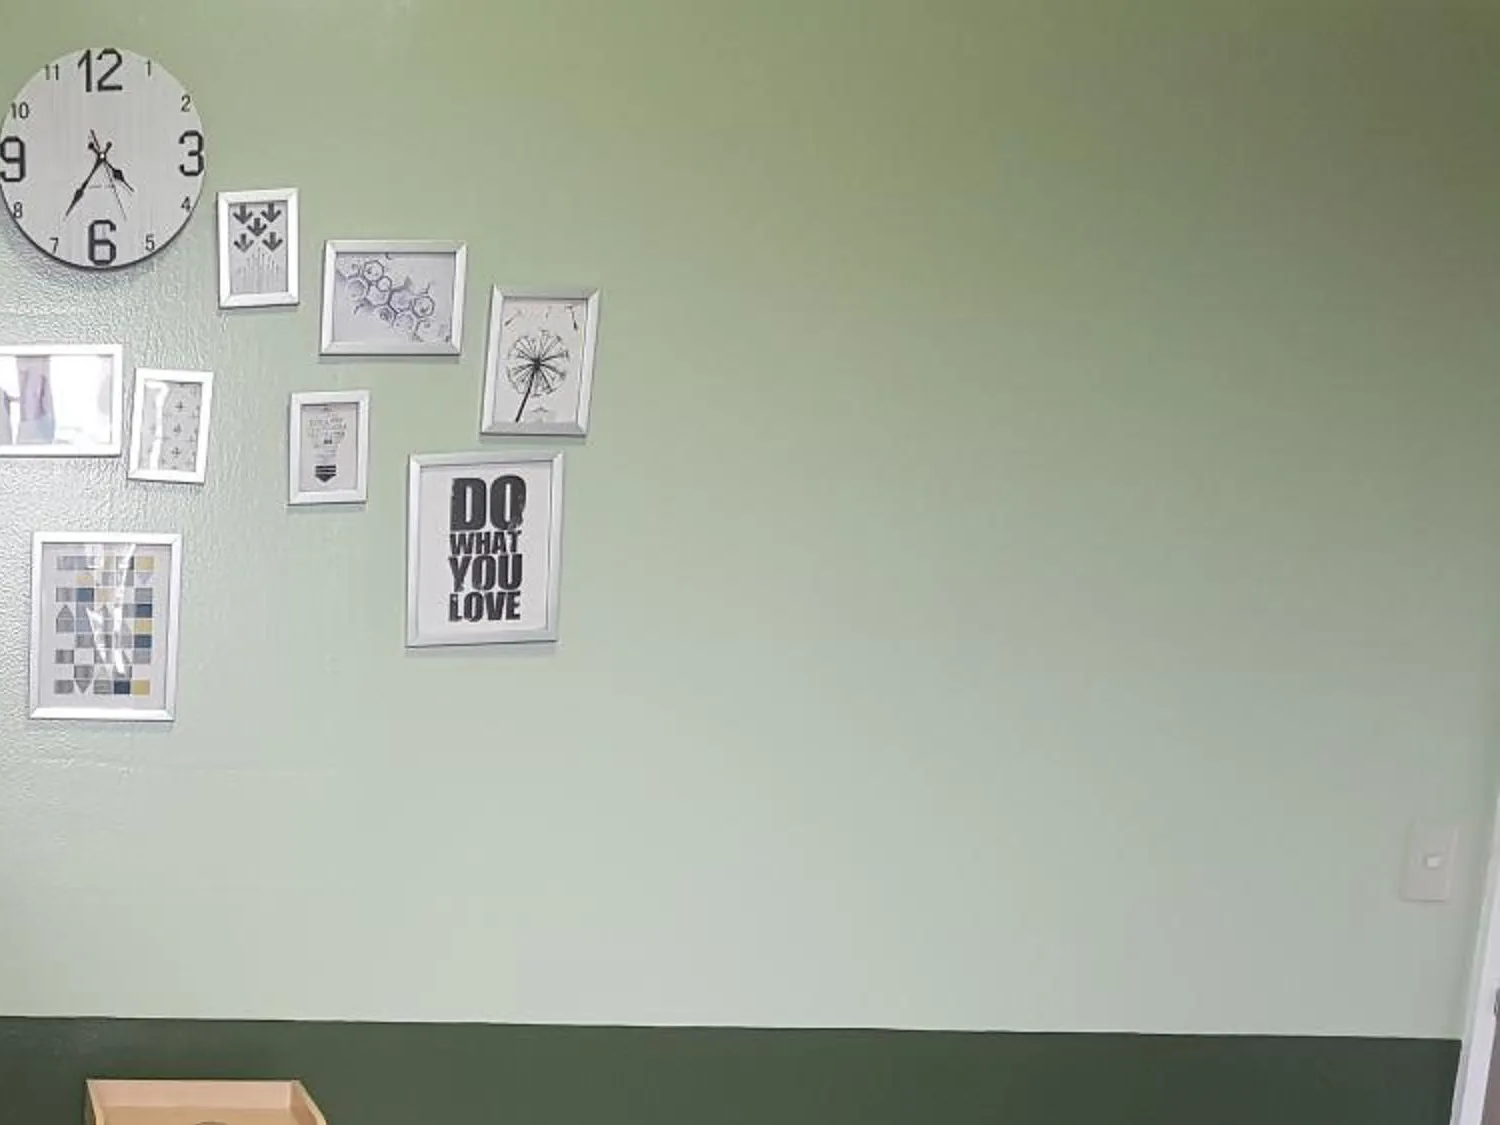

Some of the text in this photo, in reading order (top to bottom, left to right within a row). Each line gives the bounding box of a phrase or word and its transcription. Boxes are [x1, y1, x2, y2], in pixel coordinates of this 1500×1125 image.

[45, 64, 60, 80] 11
[77, 48, 123, 93] 12
[145, 60, 152, 77] 1
[11, 102, 30, 119] 10
[181, 94, 192, 112] 2
[0, 136, 26, 182] 9
[179, 130, 204, 177] 3
[13, 201, 24, 219] 8
[181, 196, 191, 212] 4
[50, 237, 60, 254] 7
[88, 219, 117, 266] 6
[145, 233, 155, 252] 5
[450, 474, 527, 531] DO
[449, 530, 522, 555] WHAT
[448, 553, 523, 592] YOU
[448, 591, 521, 623] LOVE
